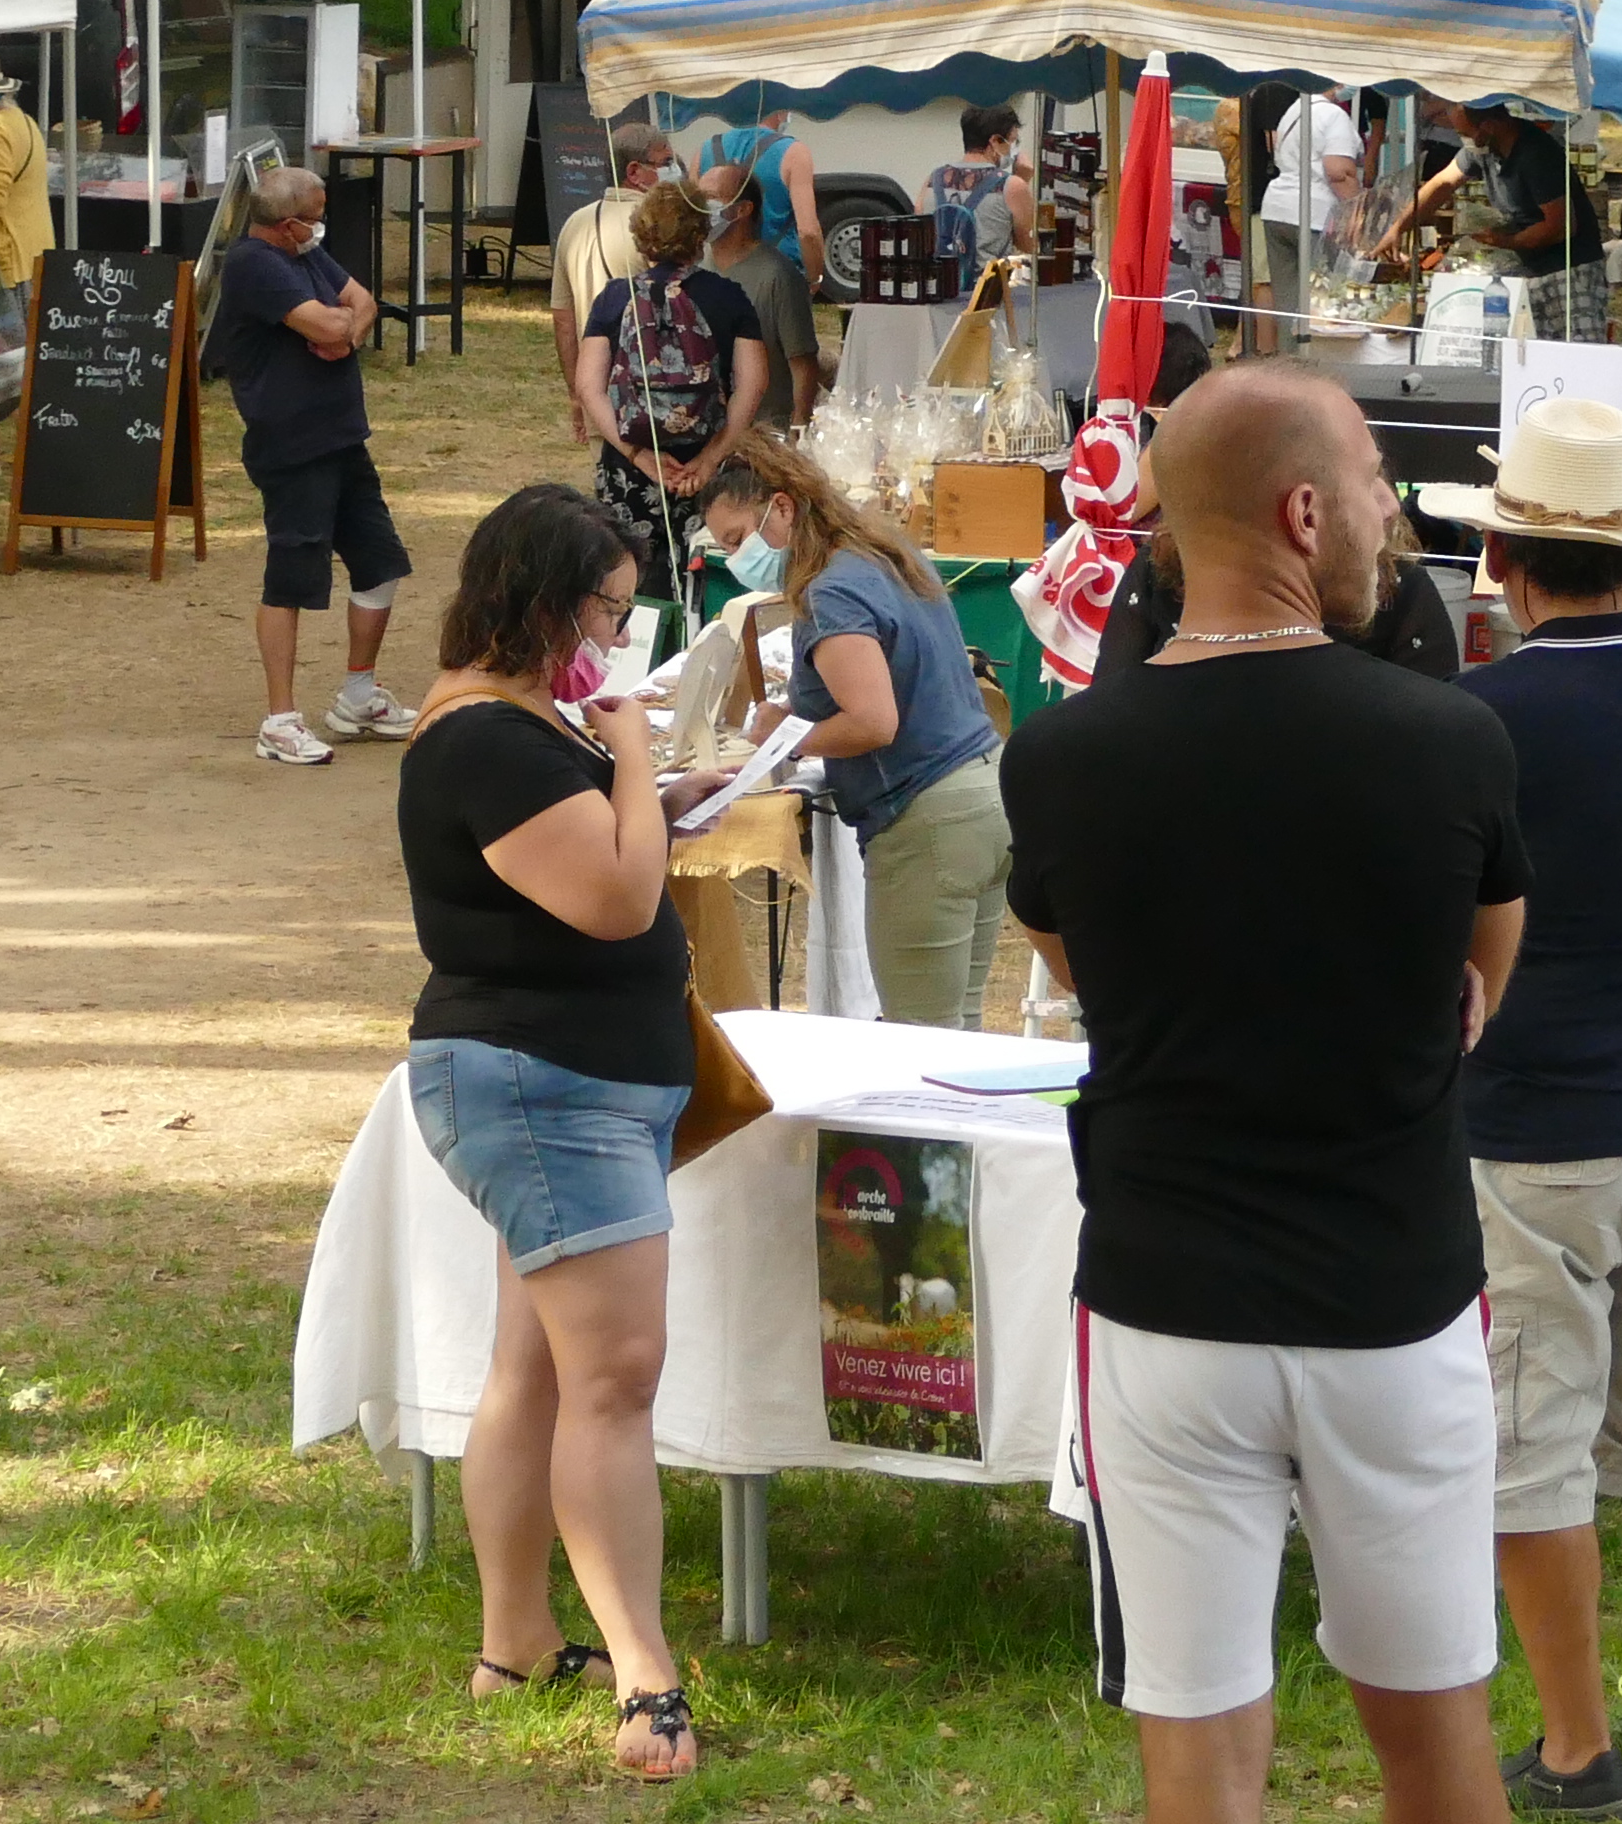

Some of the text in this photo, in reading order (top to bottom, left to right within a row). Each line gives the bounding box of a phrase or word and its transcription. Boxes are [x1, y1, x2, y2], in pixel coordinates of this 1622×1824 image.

[98, 257, 138, 290] Menu
[843, 1205, 896, 1223] ombraille
[834, 1349, 966, 1387] Venez vivre ici !
